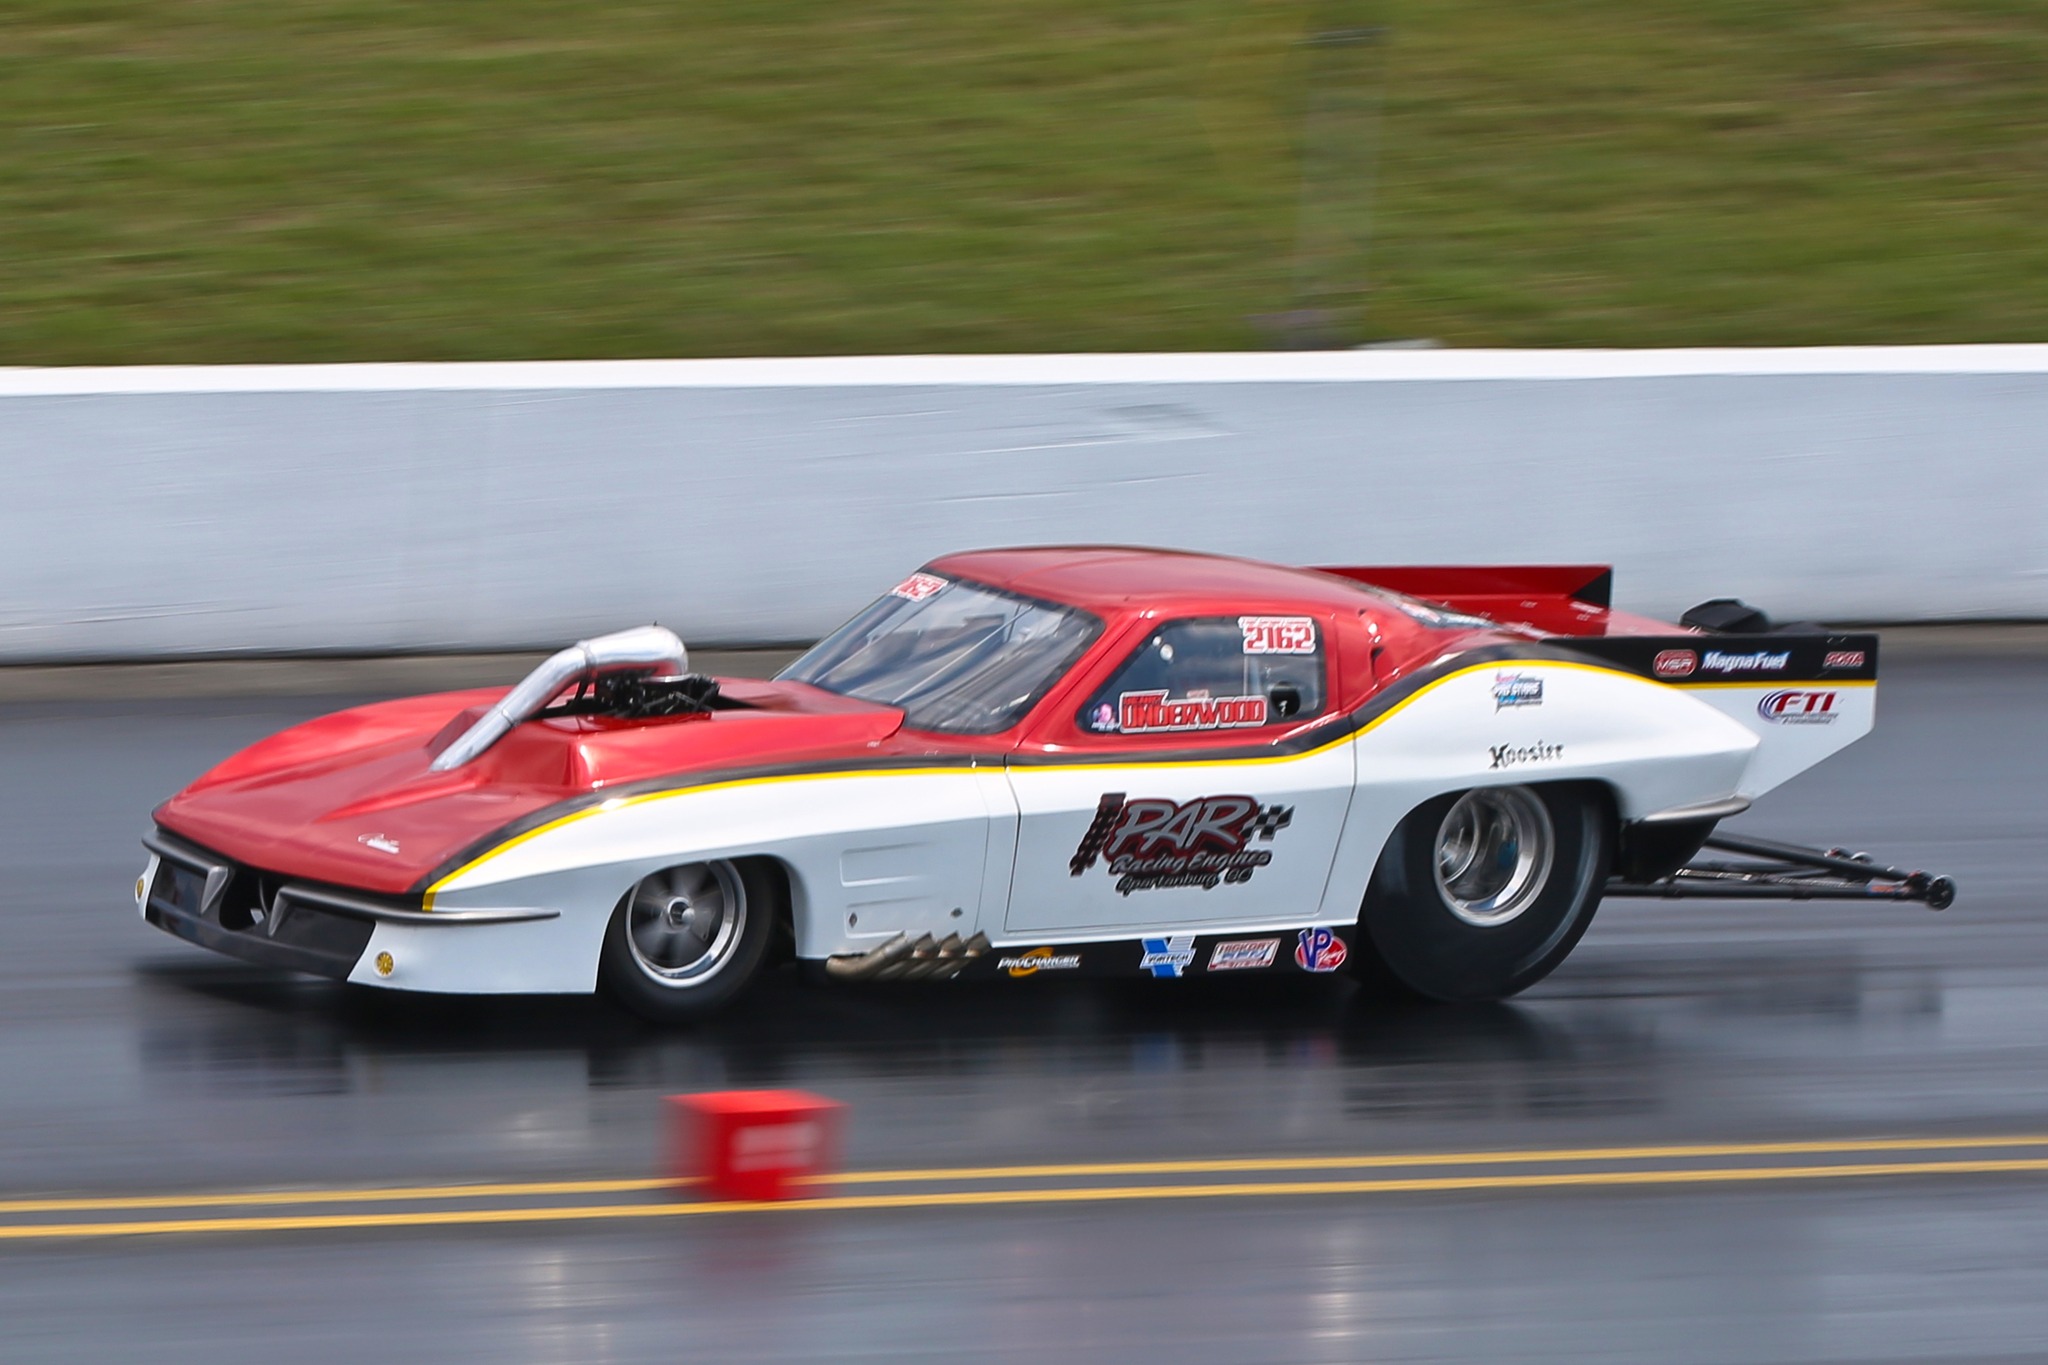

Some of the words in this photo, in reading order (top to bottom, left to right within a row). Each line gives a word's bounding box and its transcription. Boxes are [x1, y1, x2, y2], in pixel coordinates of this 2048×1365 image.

[1246, 626, 1311, 649] 2162
[1701, 650, 1792, 673] MagnaFuel
[1122, 701, 1265, 728] UNDERWOOD
[1775, 691, 1837, 713] FTI
[1488, 739, 1564, 769] Hoosier
[1108, 801, 1250, 853] PAR
[1109, 852, 1187, 875] Racing
[1298, 926, 1333, 969] VP
